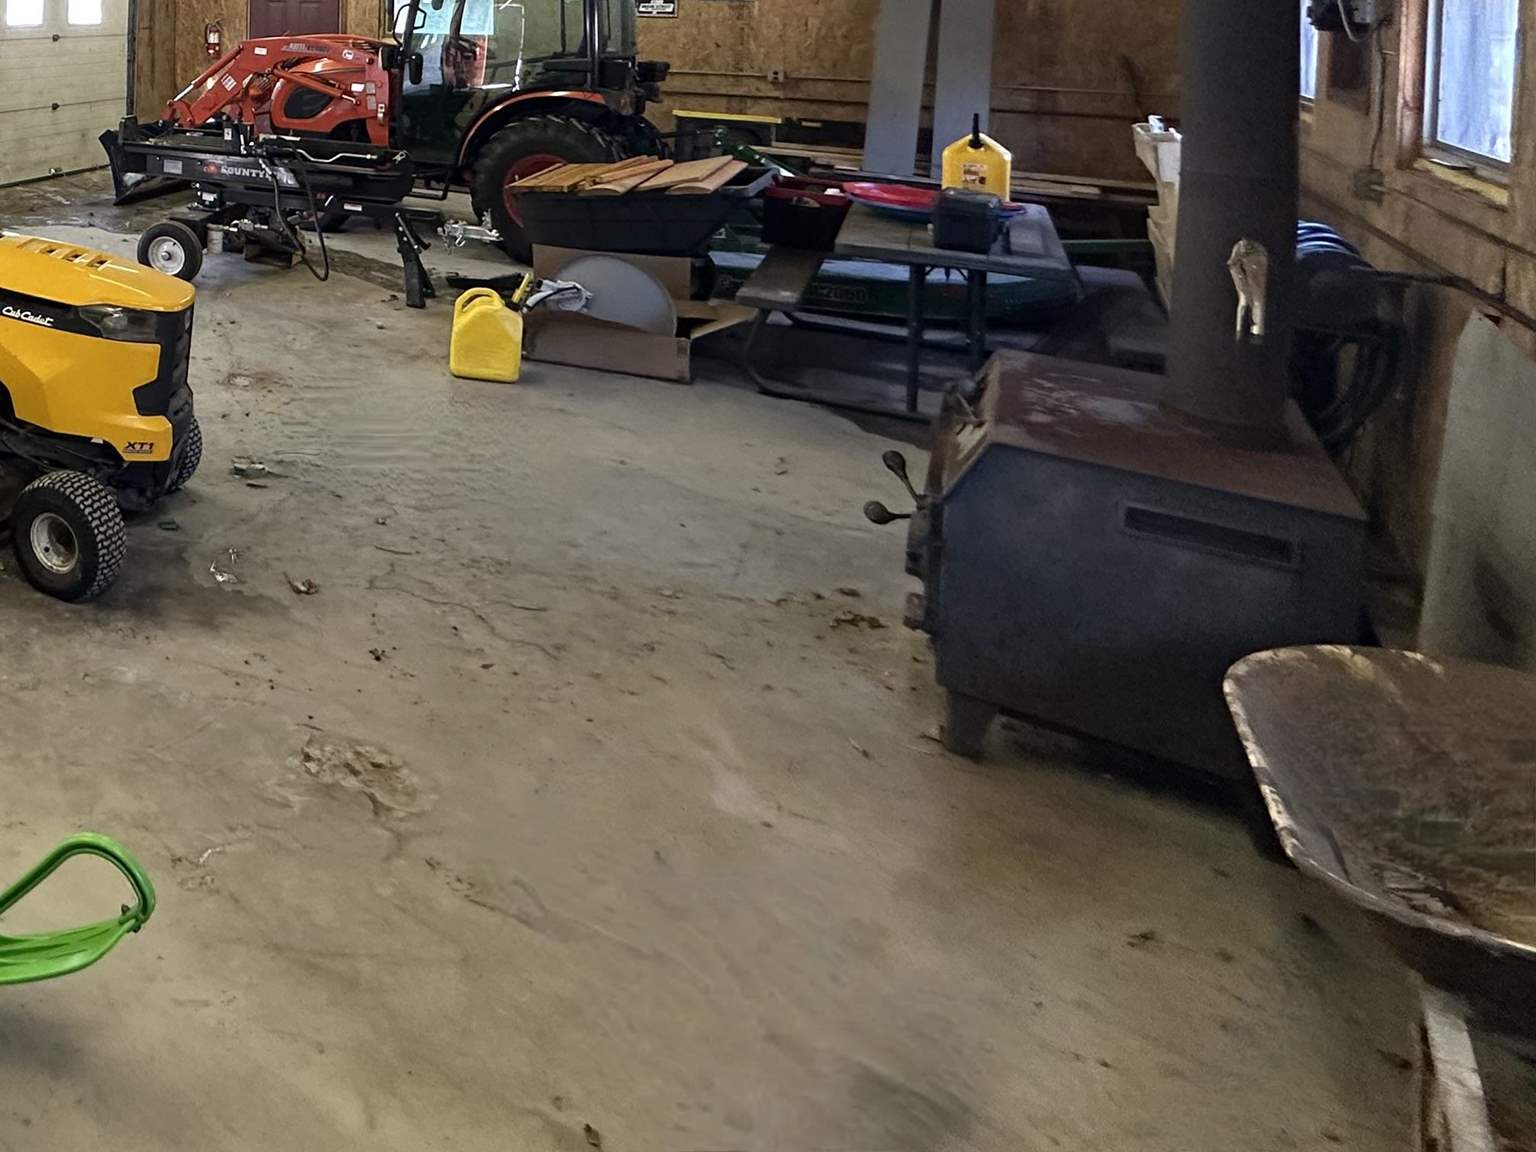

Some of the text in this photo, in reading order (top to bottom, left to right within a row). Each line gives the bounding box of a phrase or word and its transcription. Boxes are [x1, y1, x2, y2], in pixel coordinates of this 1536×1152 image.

[1, 306, 55, 327] Cub Cadet
[126, 441, 154, 450] XT1
